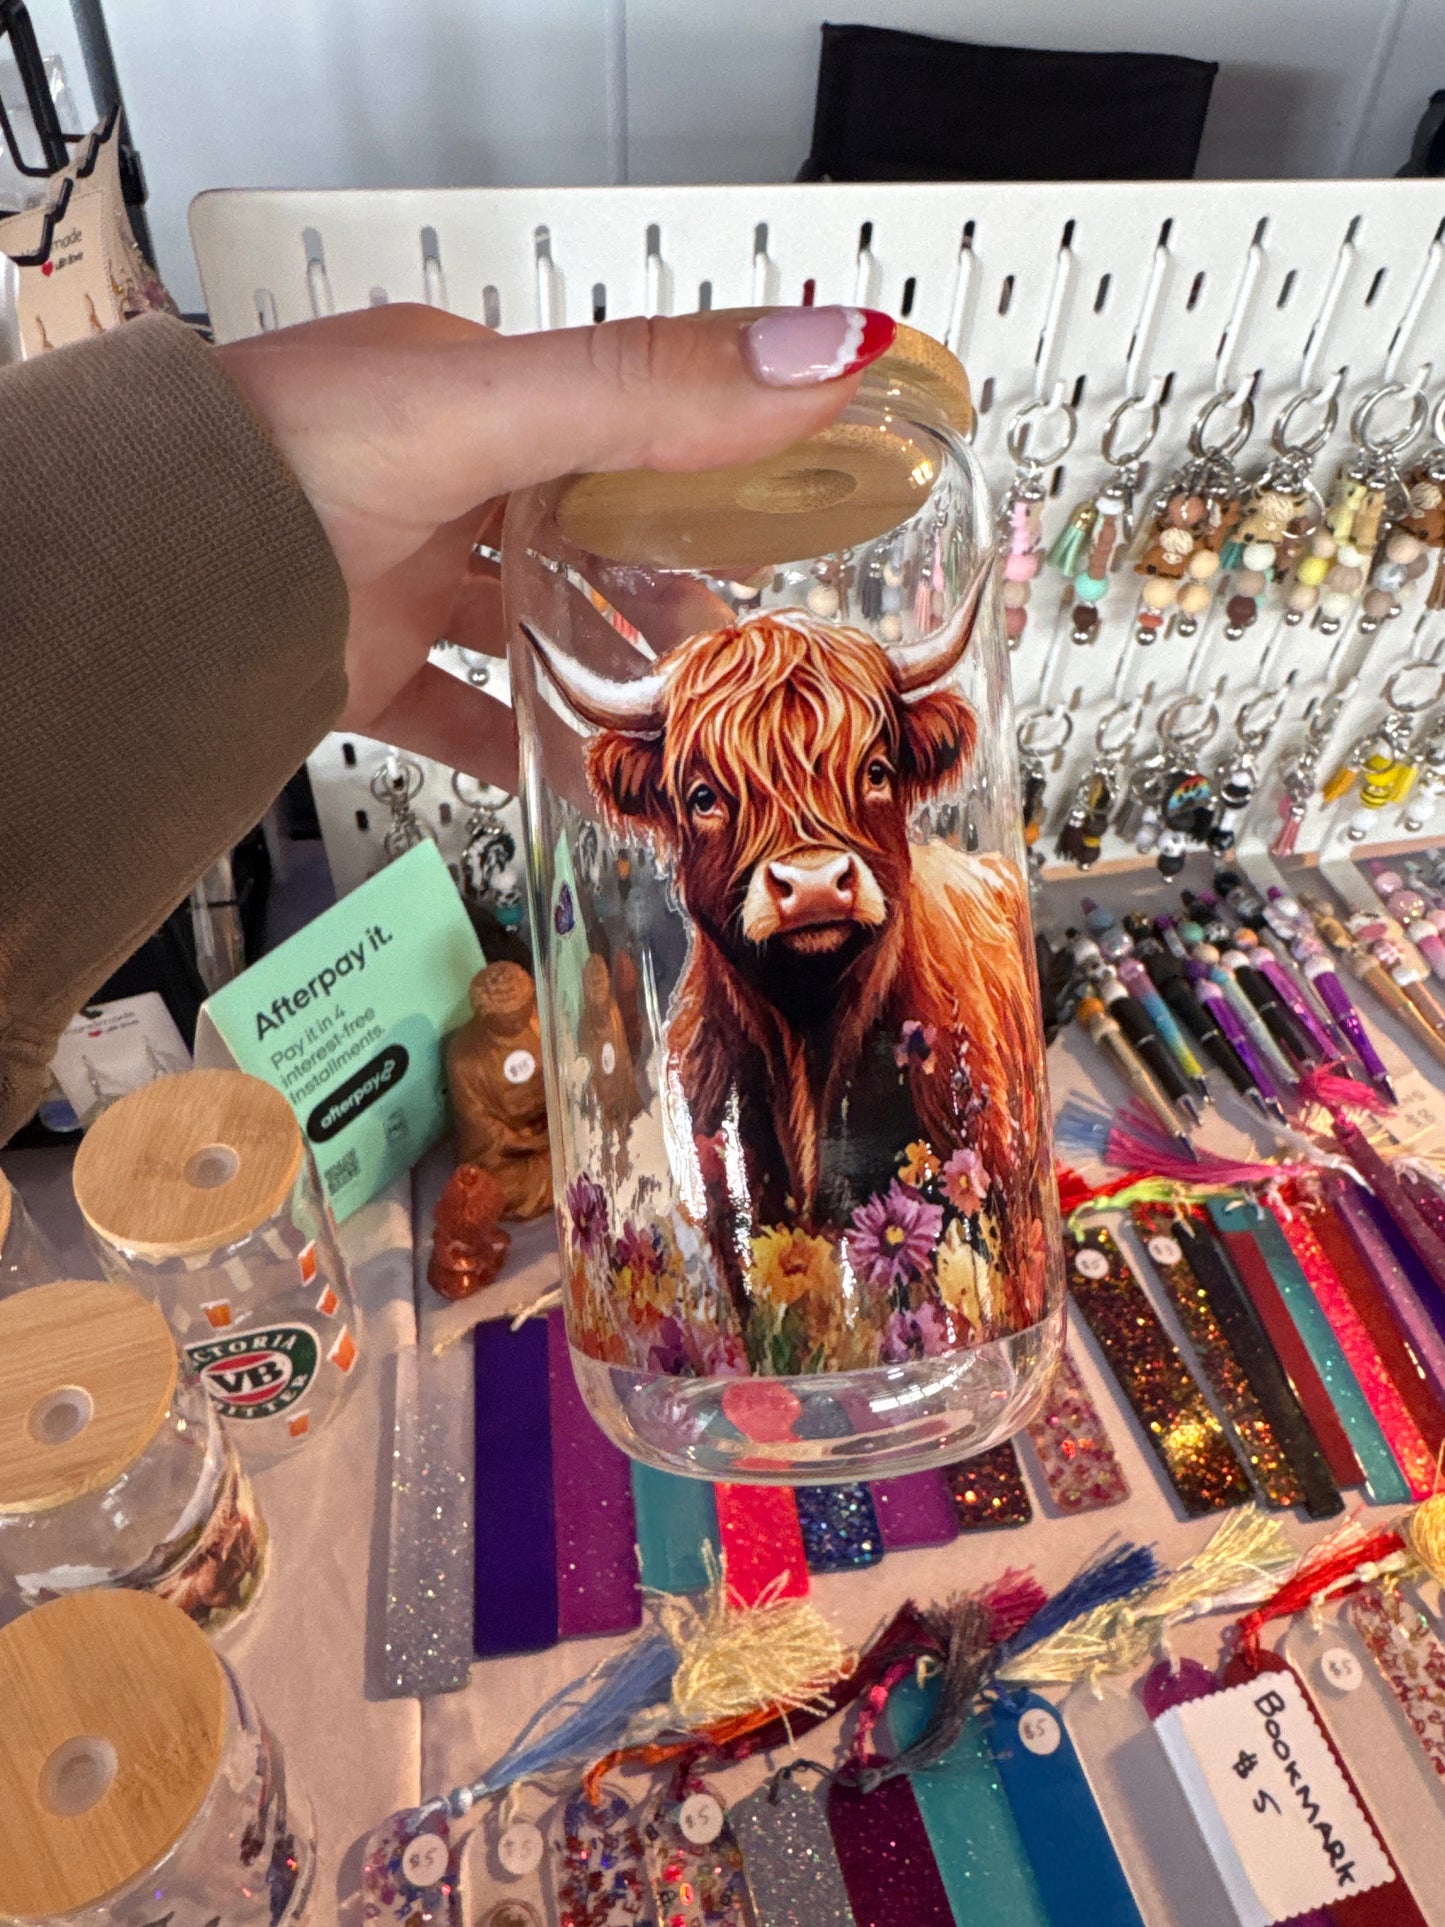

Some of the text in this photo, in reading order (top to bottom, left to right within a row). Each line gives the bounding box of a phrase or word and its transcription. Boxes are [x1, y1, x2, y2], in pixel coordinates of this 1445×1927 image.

[256, 925, 393, 1041] Afterpay it.
[270, 1003, 345, 1071] Pay it in 4
[280, 1006, 376, 1089] interest-free
[320, 1071, 380, 1129] afterpay
[191, 1332, 298, 1366] CTORIA
[206, 1360, 284, 1394] VB
[685, 1803, 709, 1830] $5
[1253, 1689, 1356, 1888] BOOKMARK
